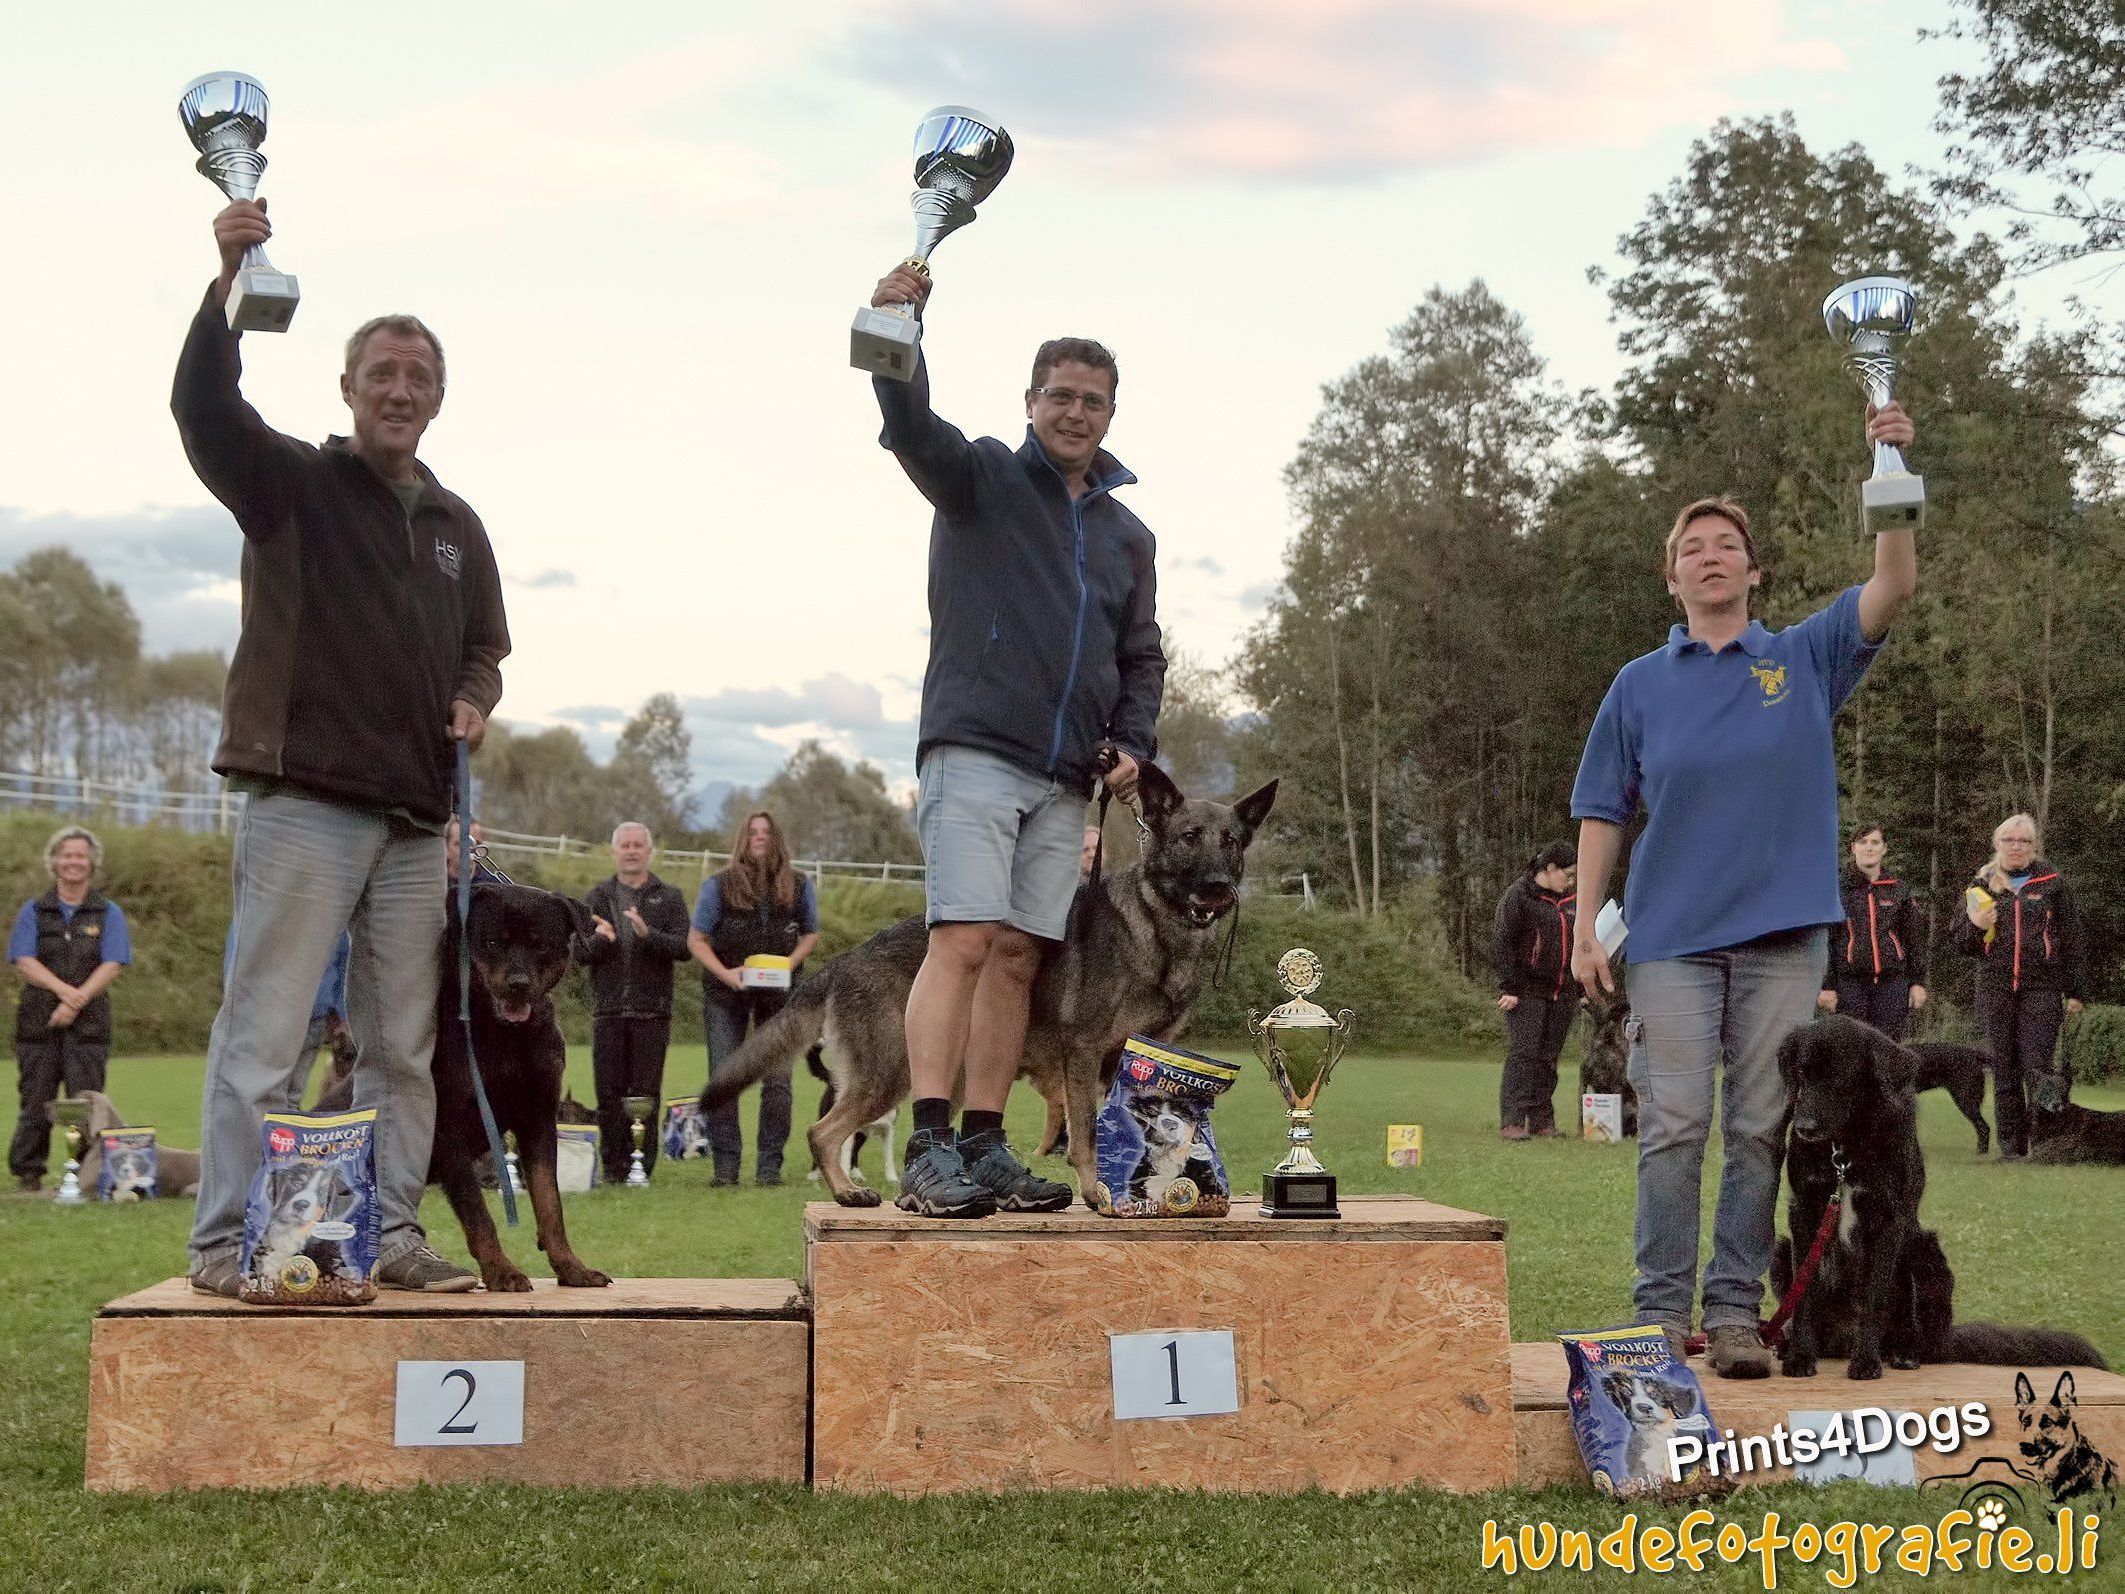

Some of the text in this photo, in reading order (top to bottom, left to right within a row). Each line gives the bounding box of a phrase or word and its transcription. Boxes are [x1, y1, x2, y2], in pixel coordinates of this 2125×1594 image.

[1131, 1059, 1154, 1081] Rupp
[1161, 1340, 1187, 1405] 1
[1607, 1352, 1671, 1367] BROCKEN
[438, 1368, 478, 1434] 2
